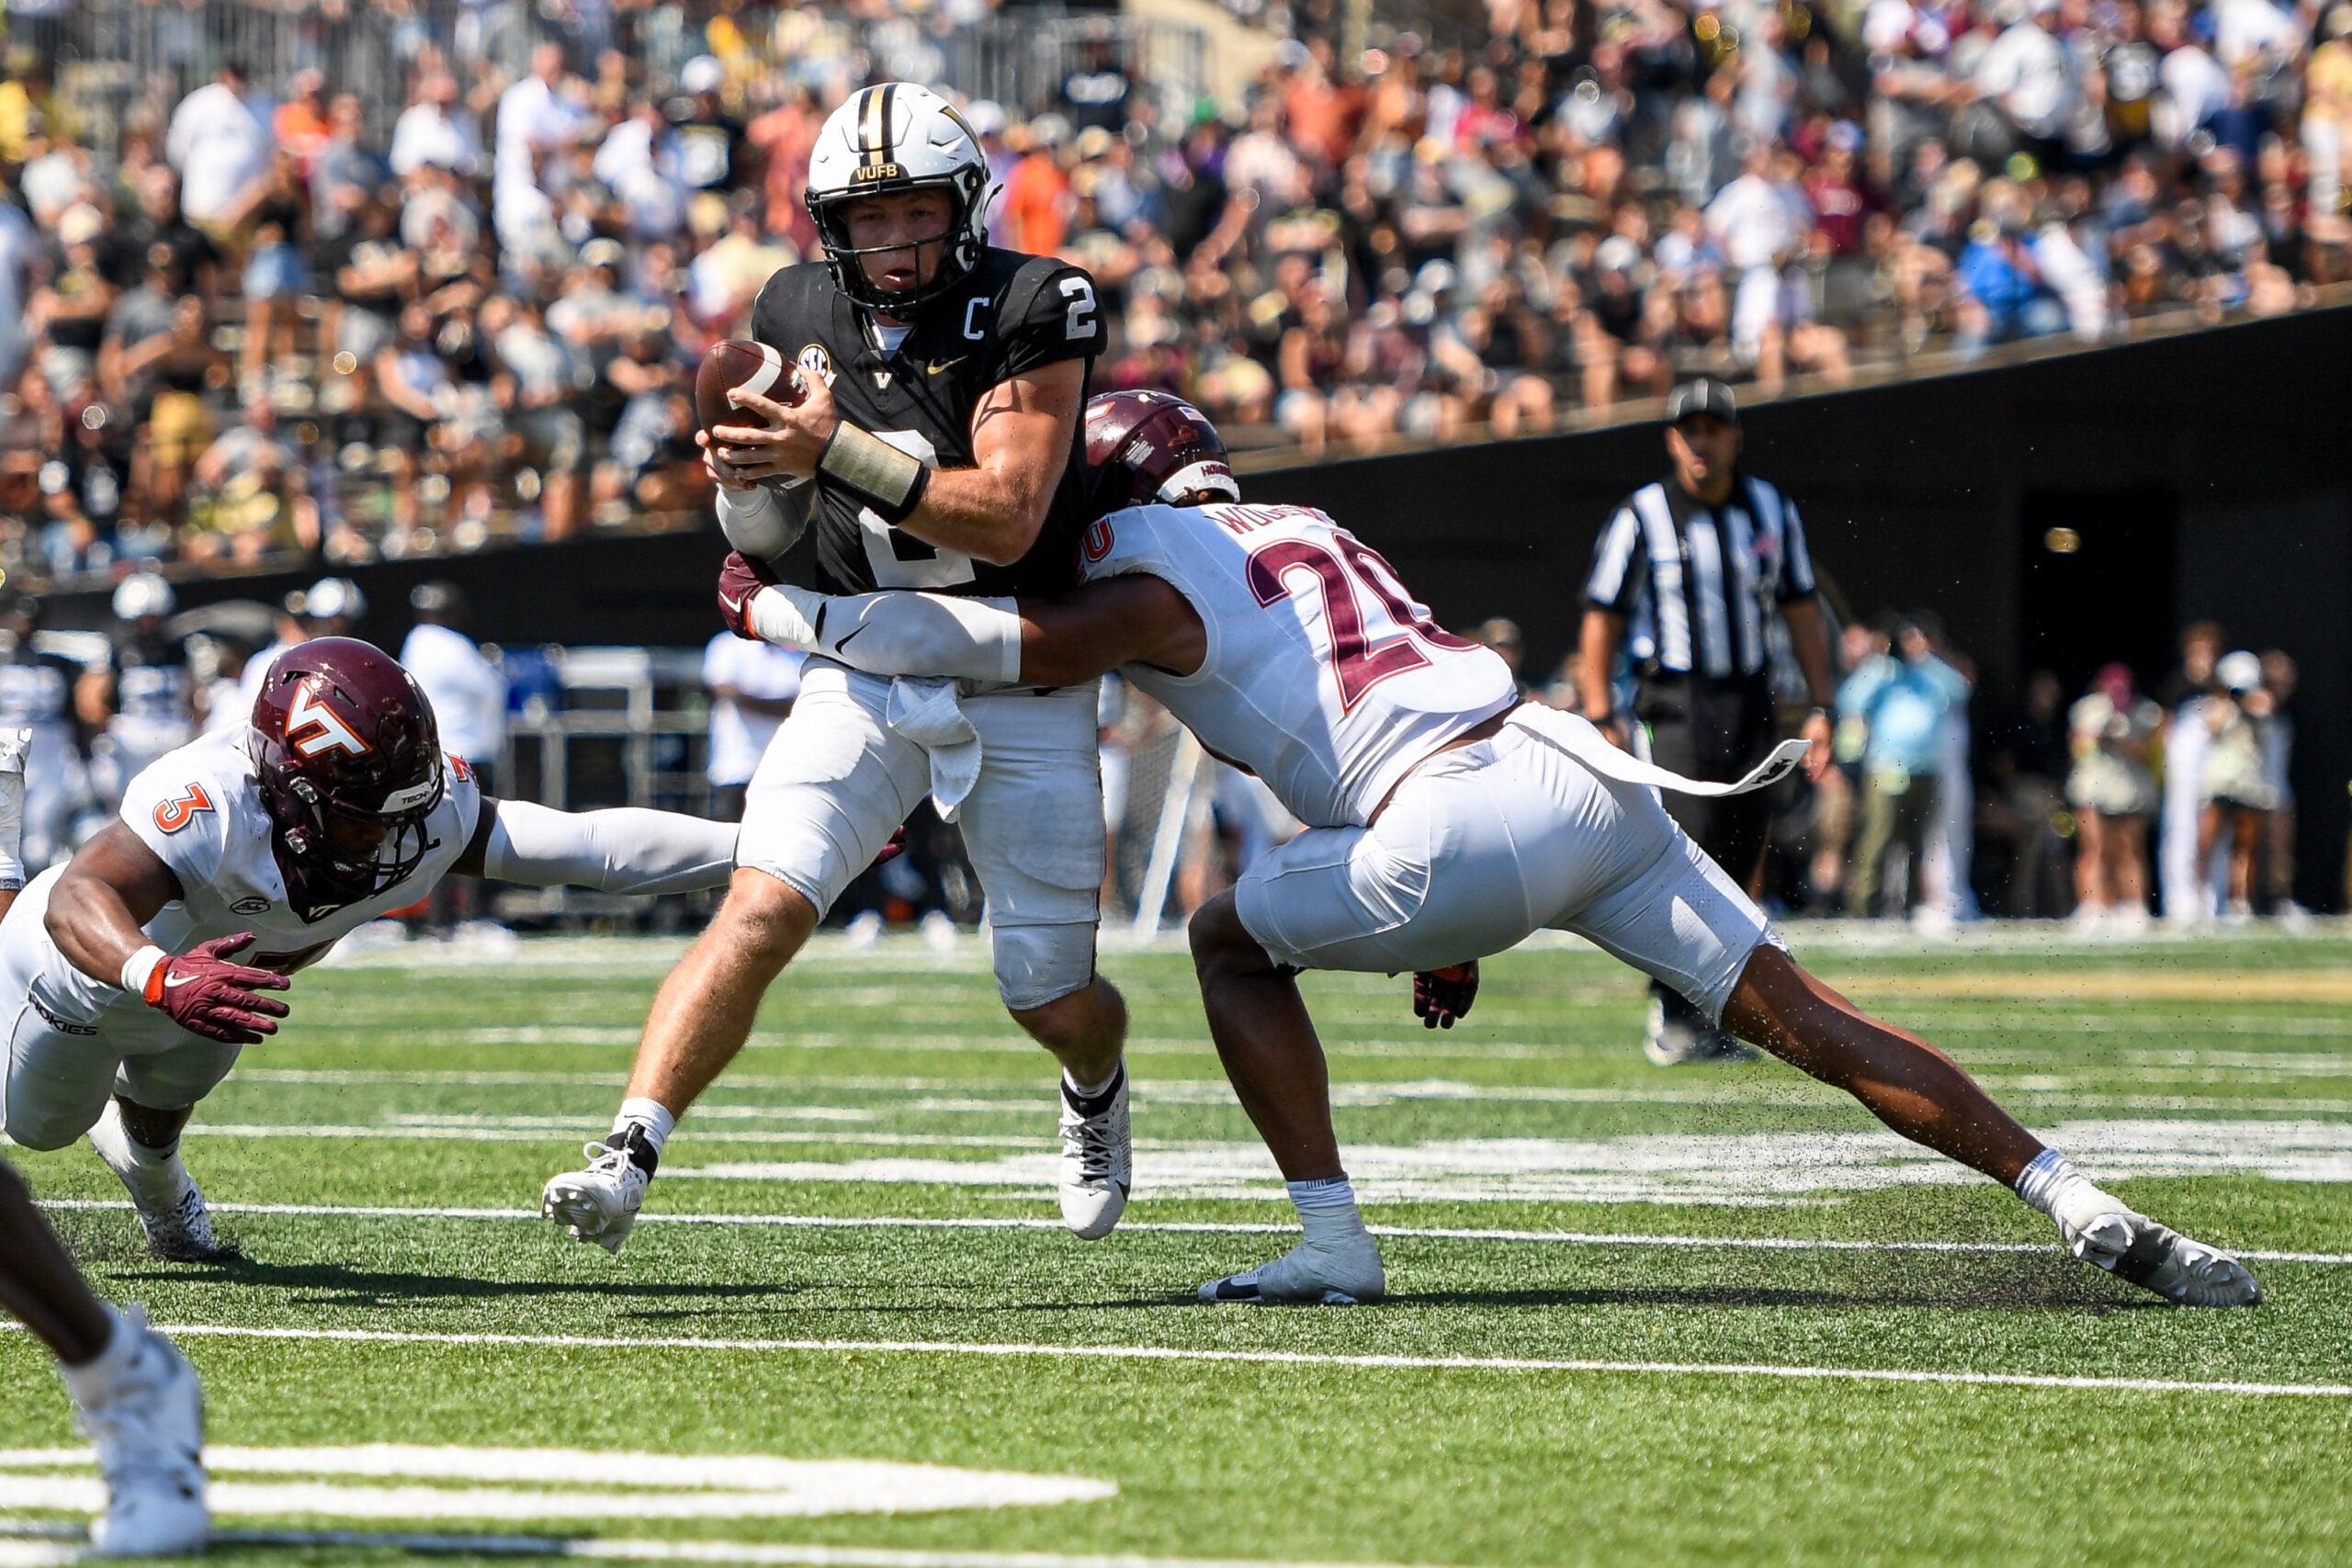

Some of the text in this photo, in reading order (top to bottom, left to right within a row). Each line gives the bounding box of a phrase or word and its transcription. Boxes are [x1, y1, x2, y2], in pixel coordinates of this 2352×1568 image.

[856, 164, 898, 181] VUFB
[964, 298, 989, 340] C
[1059, 276, 1097, 340] 2
[874, 372, 893, 389] V
[1246, 530, 1485, 716] 20
[285, 678, 373, 758] VT
[153, 781, 216, 836] 3
